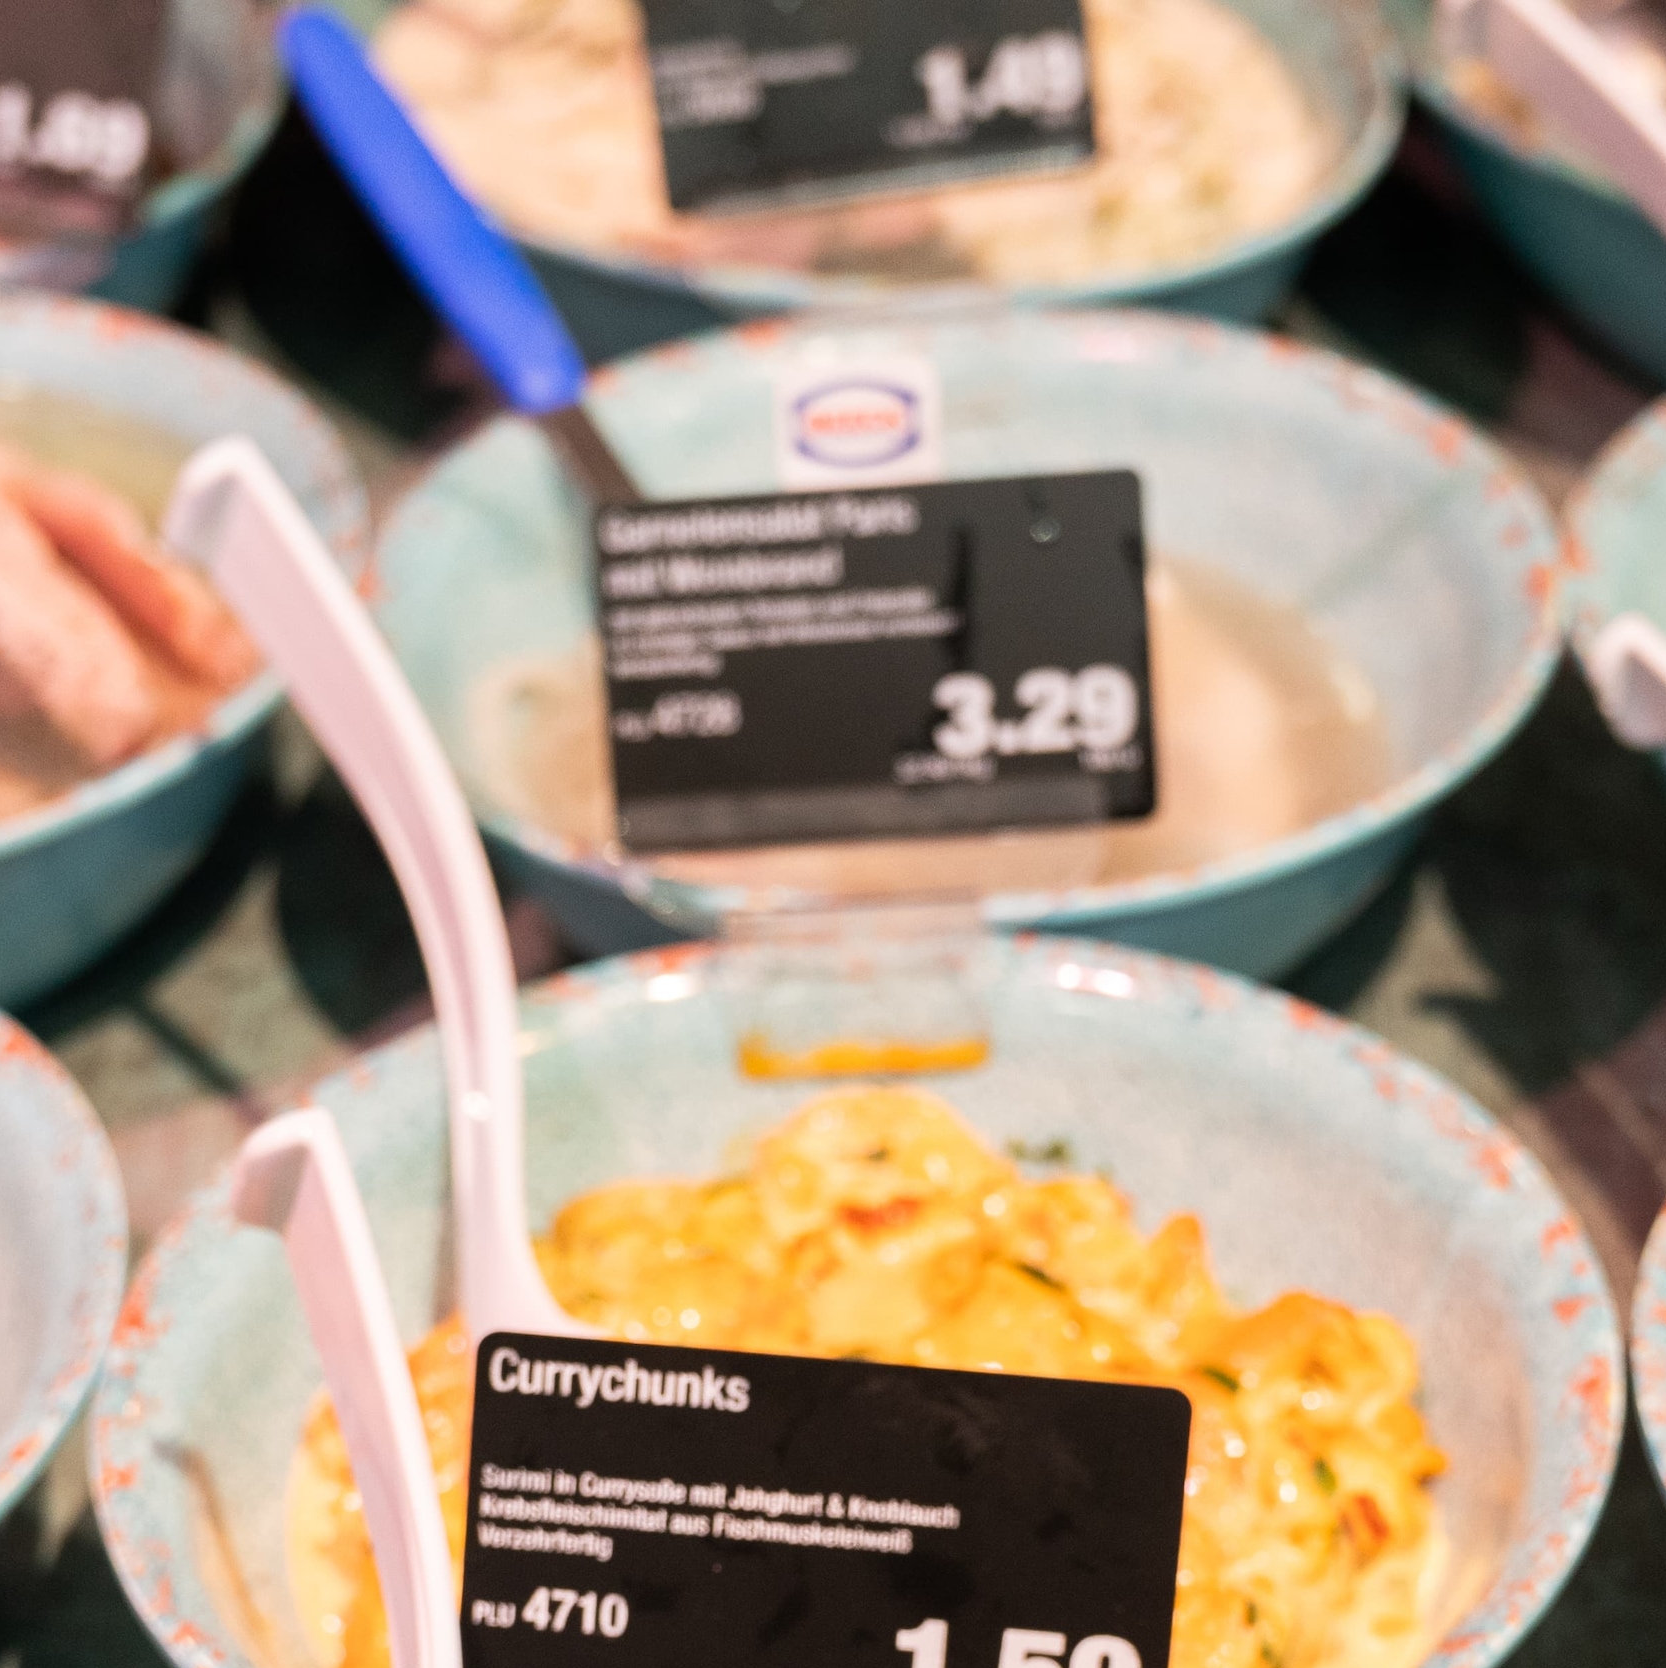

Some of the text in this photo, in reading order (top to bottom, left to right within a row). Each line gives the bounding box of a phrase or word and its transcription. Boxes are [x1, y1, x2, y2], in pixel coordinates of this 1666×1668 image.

[933, 665, 1139, 759] 3.29
[488, 1347, 749, 1412] Currychunks
[551, 1469, 578, 1496] in
[823, 1491, 846, 1520] &
[476, 1522, 614, 1562] Verzehrfertig
[667, 1511, 711, 1537] aus
[470, 1585, 630, 1638] PLU 4710
